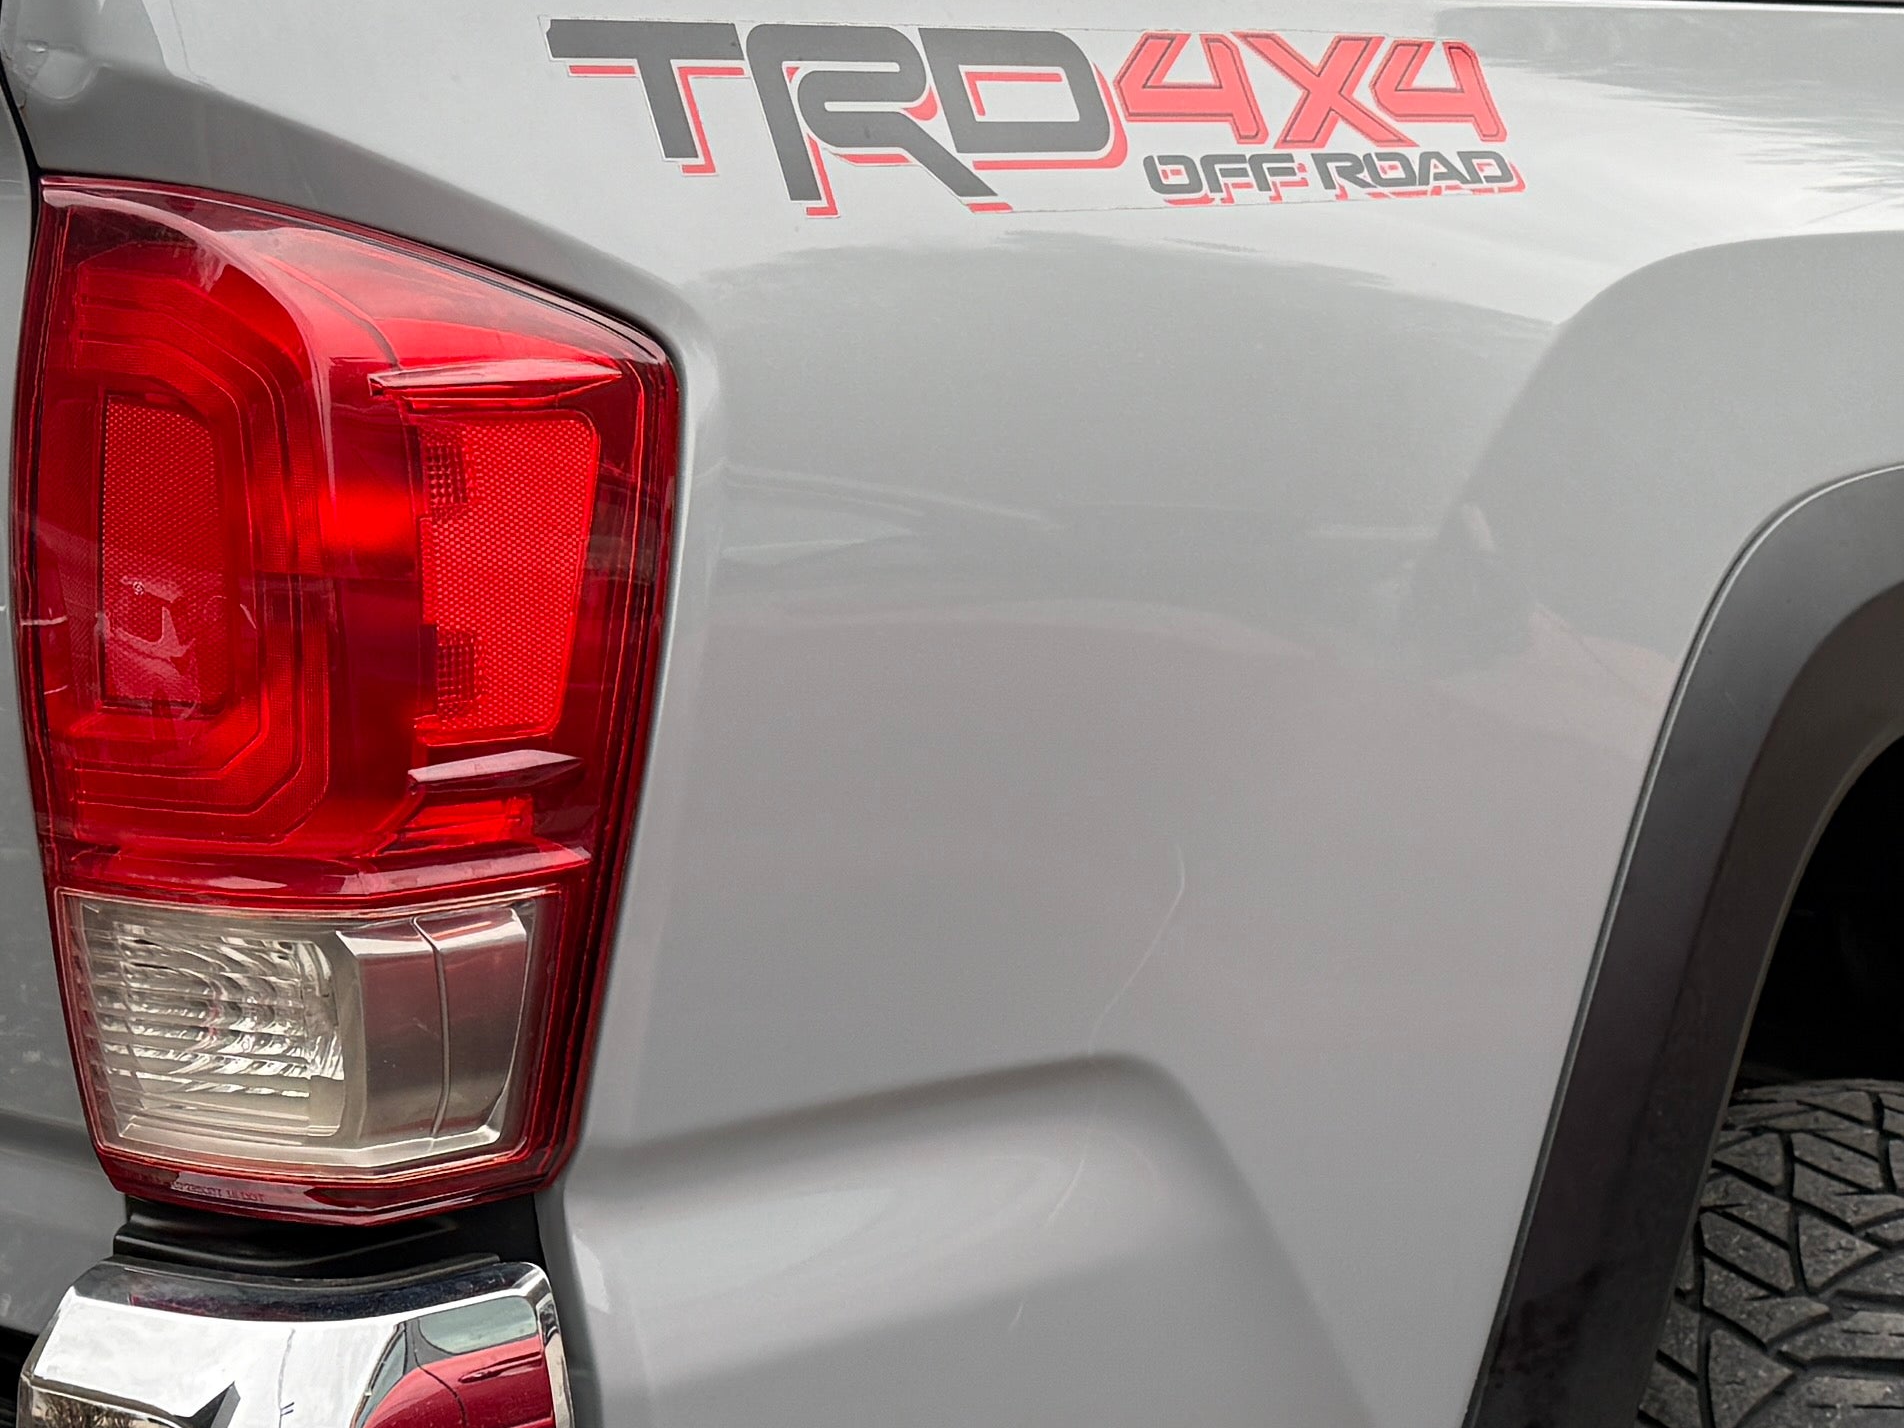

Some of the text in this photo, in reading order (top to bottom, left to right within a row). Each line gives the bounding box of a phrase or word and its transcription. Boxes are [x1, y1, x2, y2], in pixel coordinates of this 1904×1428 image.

[545, 18, 1508, 218] TRD 4X4
[1143, 148, 1526, 205] OFF ROAD
